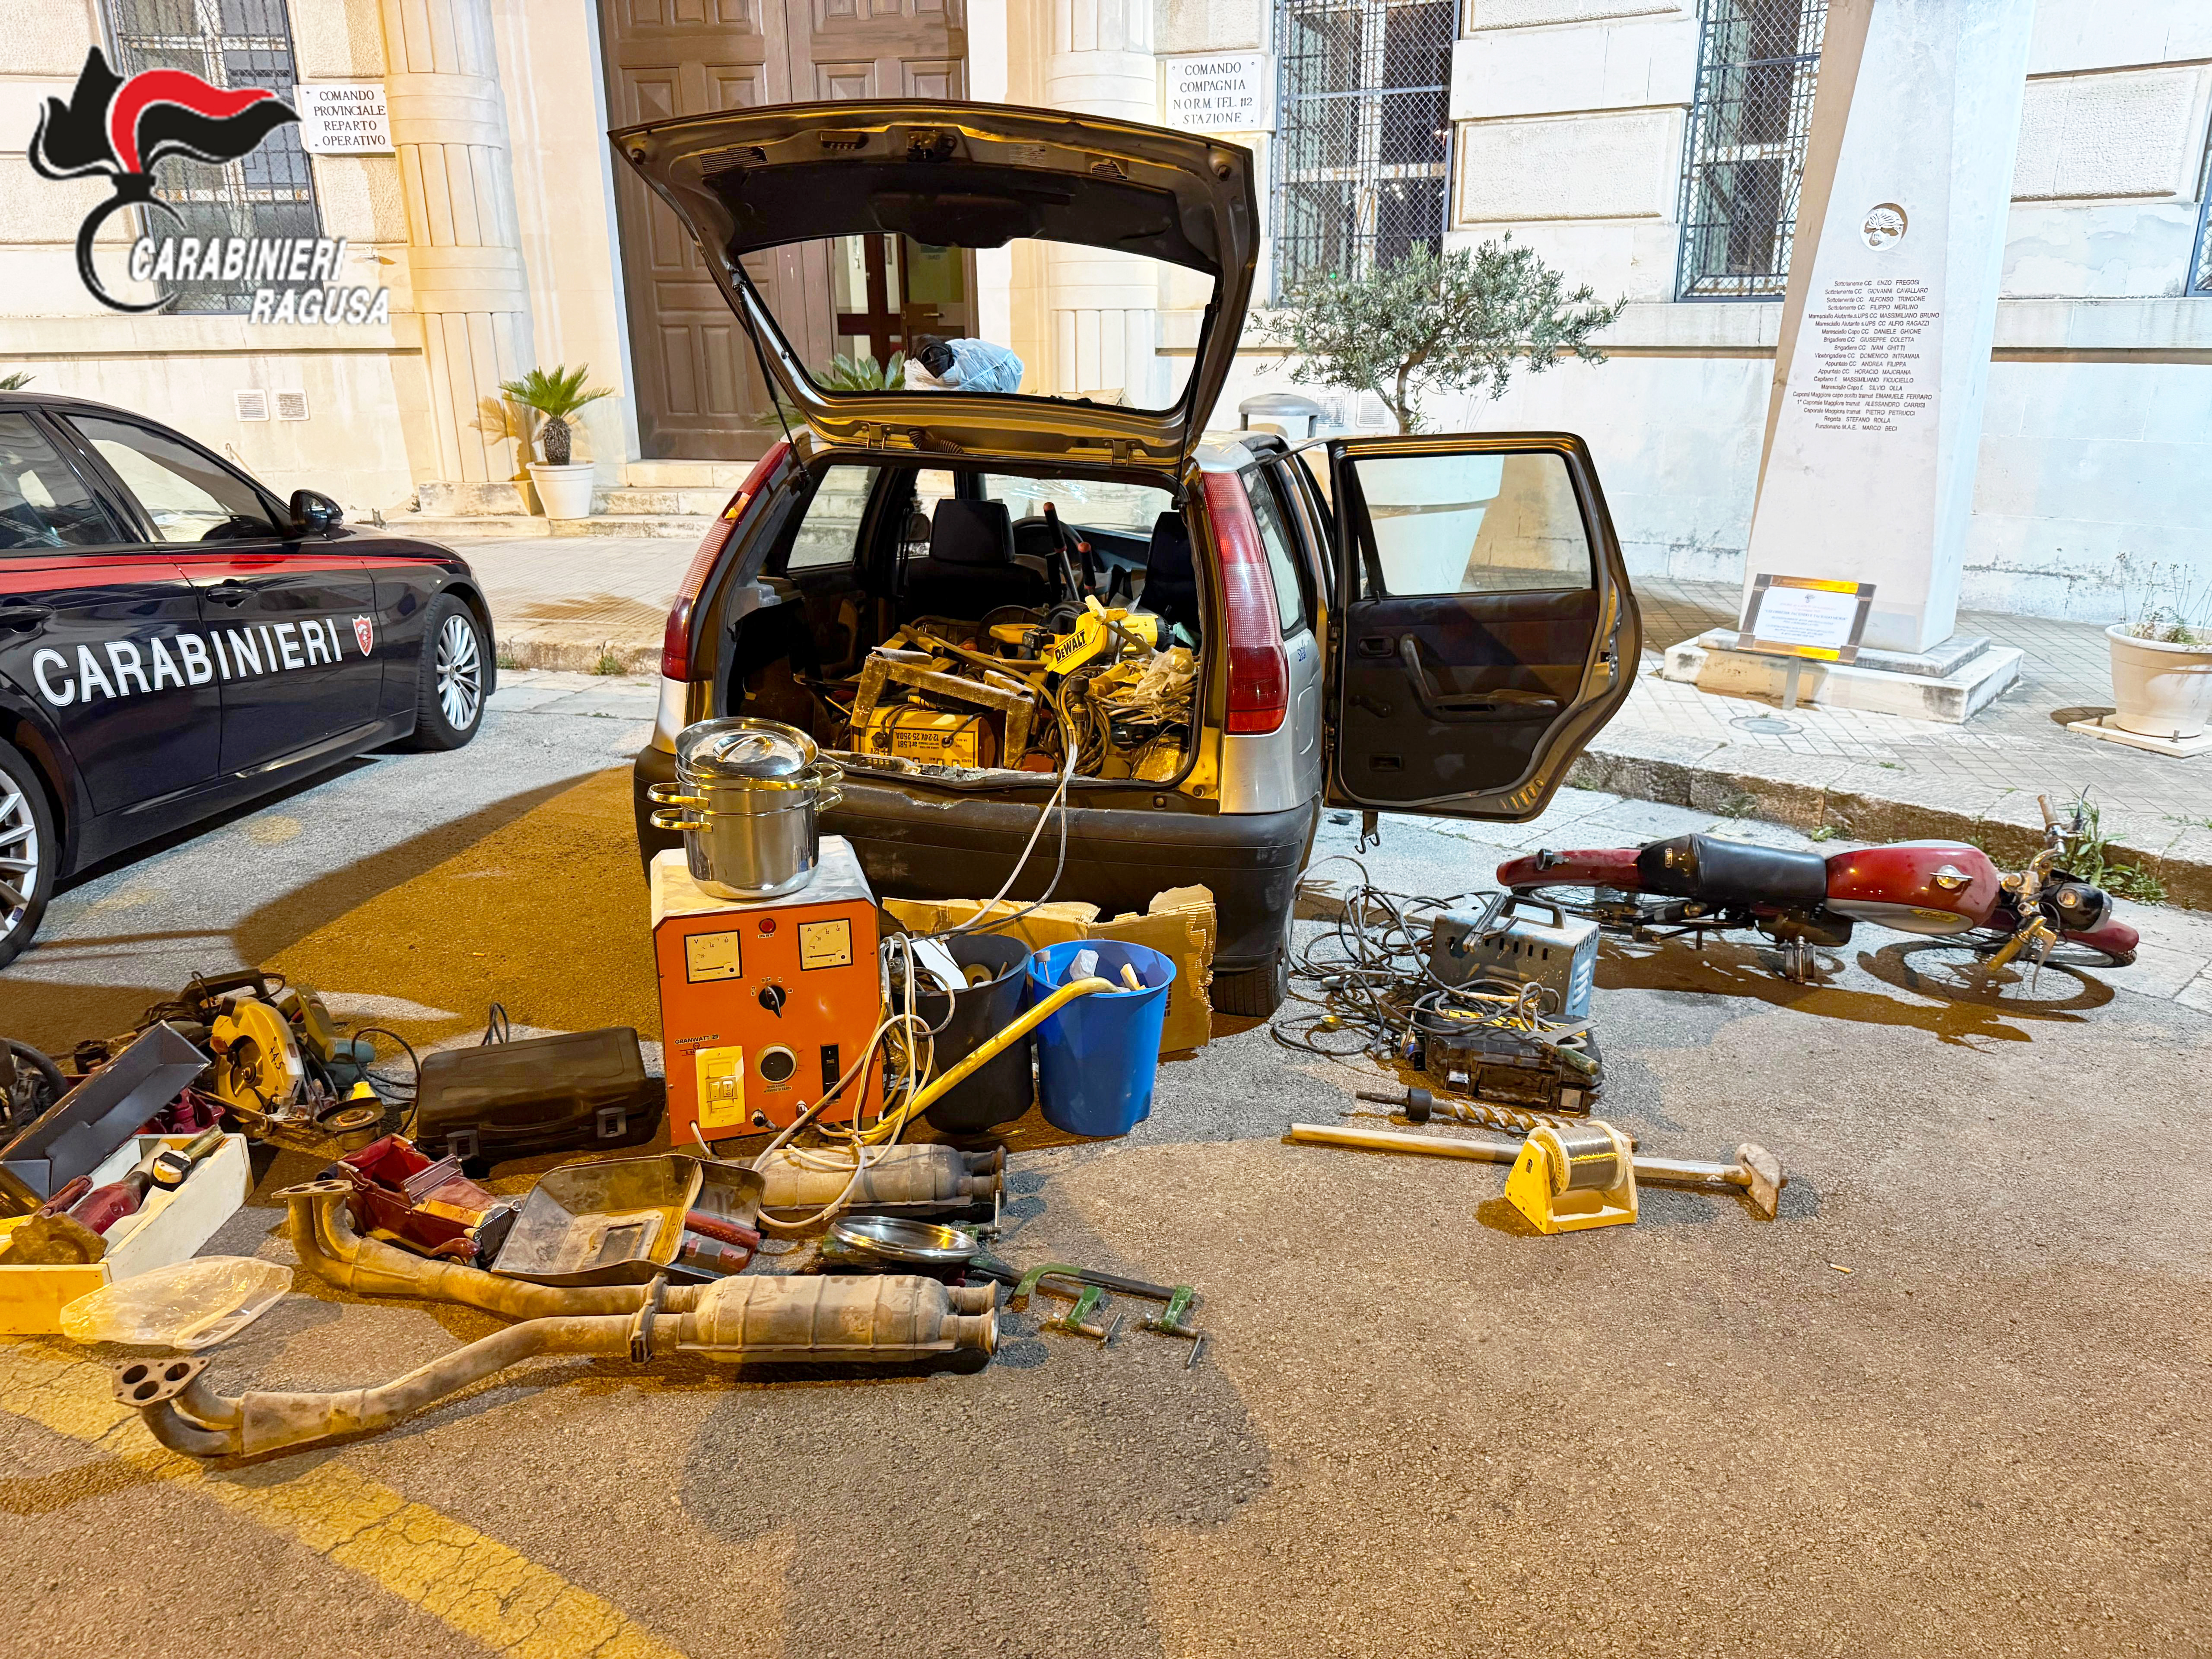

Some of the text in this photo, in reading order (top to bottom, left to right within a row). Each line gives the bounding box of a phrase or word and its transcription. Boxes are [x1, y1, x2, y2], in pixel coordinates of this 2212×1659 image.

[1185, 62, 1241, 75] COMANDO
[1180, 79, 1246, 92] COMPAGNIA
[319, 90, 374, 101] COMANDO
[1240, 97, 1252, 107] 112
[314, 105, 386, 116] PROVINCIALE
[1183, 112, 1242, 124] STAZIONE
[324, 121, 377, 130] REPARTO
[322, 135, 385, 146] OPERATIVO
[32, 618, 343, 706] CARABINIERI
[675, 1036, 709, 1044] GRANWATT
